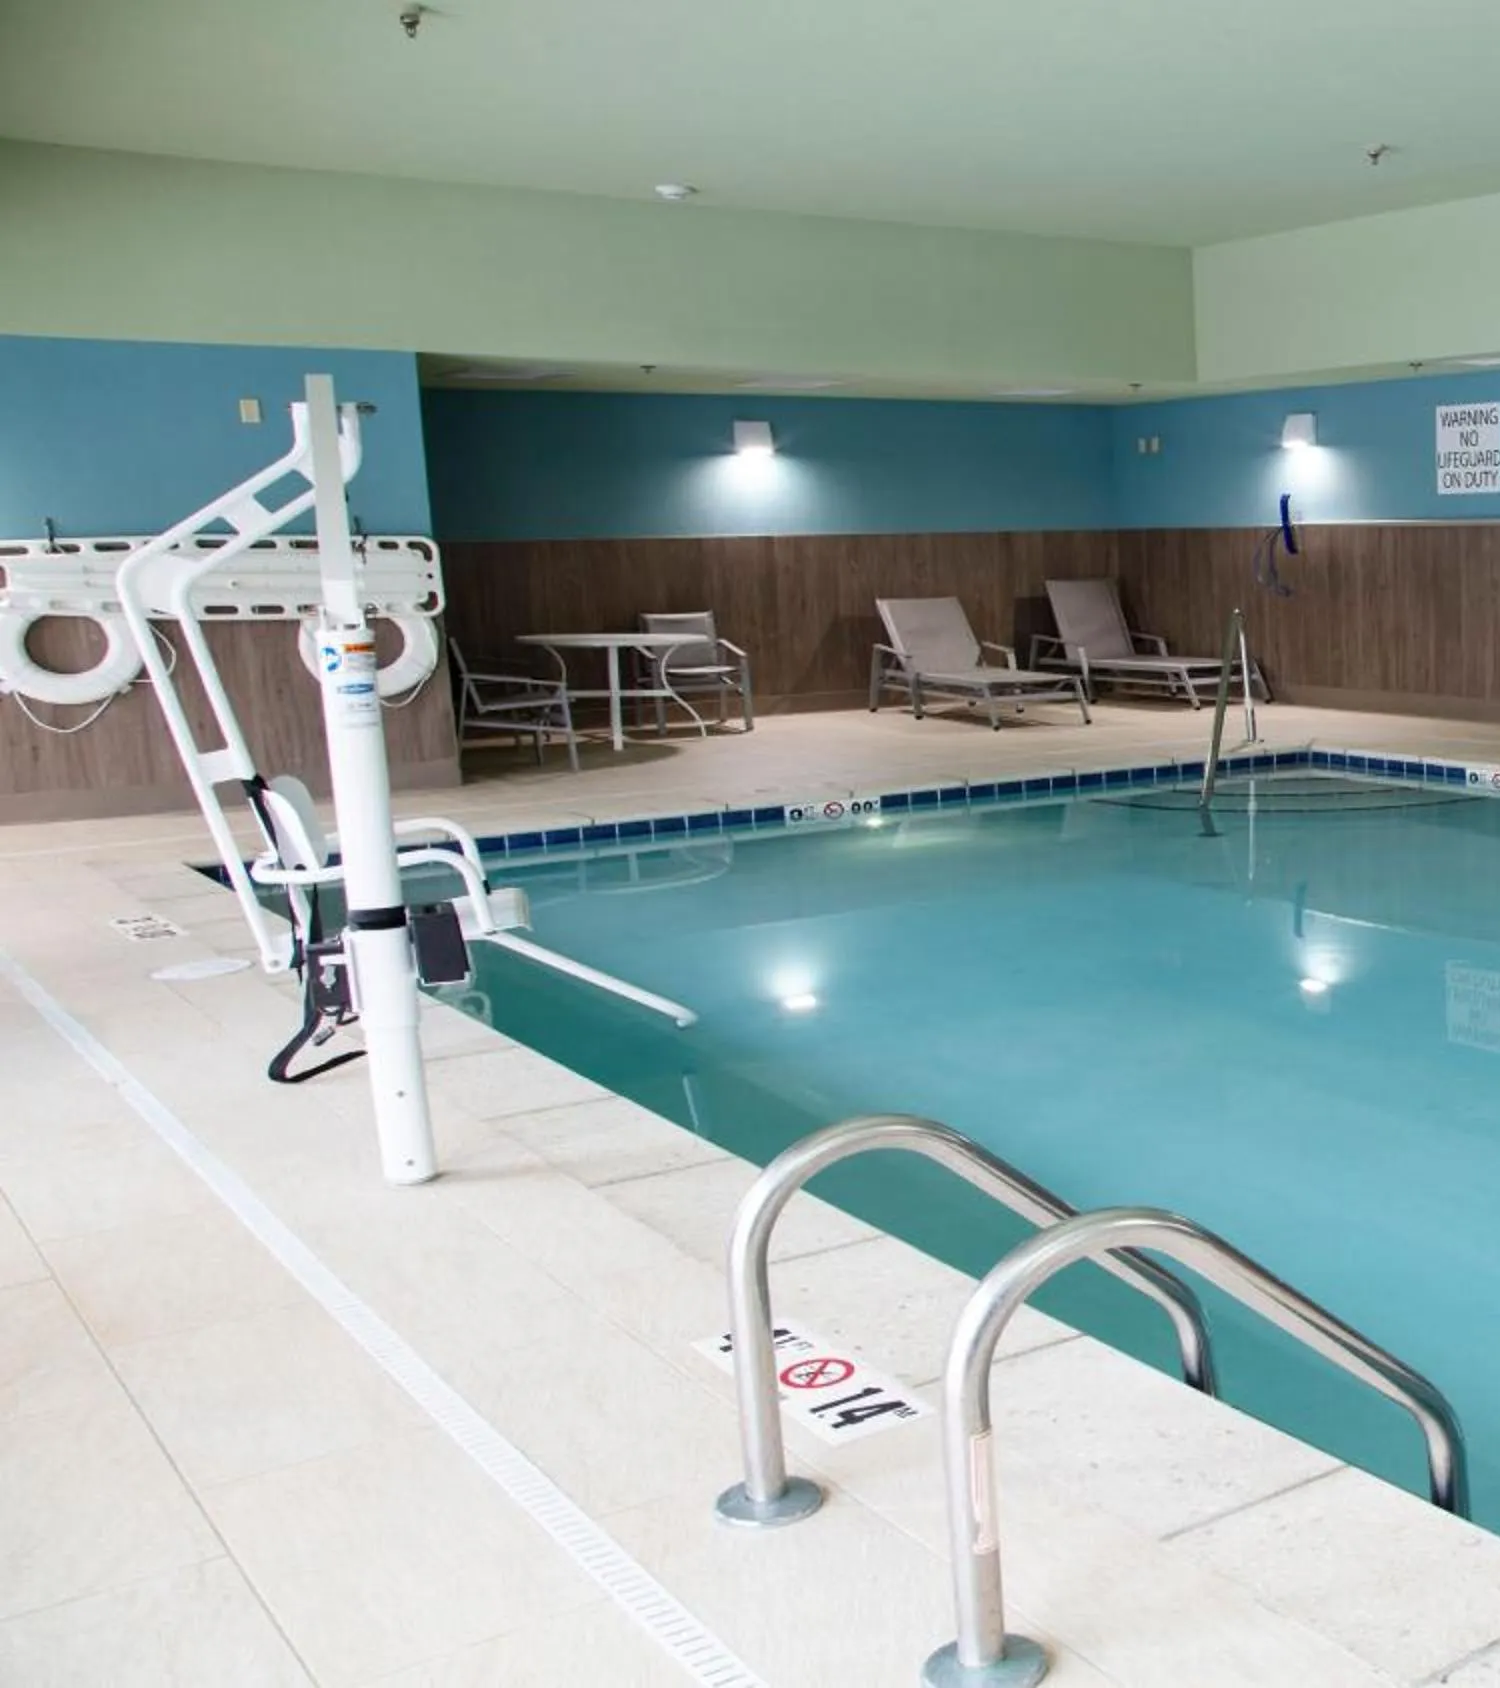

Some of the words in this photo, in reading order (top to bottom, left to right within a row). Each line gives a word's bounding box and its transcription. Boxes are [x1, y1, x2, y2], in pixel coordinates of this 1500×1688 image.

[1440, 407, 1499, 428] WARNING
[1459, 429, 1479, 447] NO
[1442, 472, 1461, 488] ON
[1464, 470, 1499, 488] DUTY
